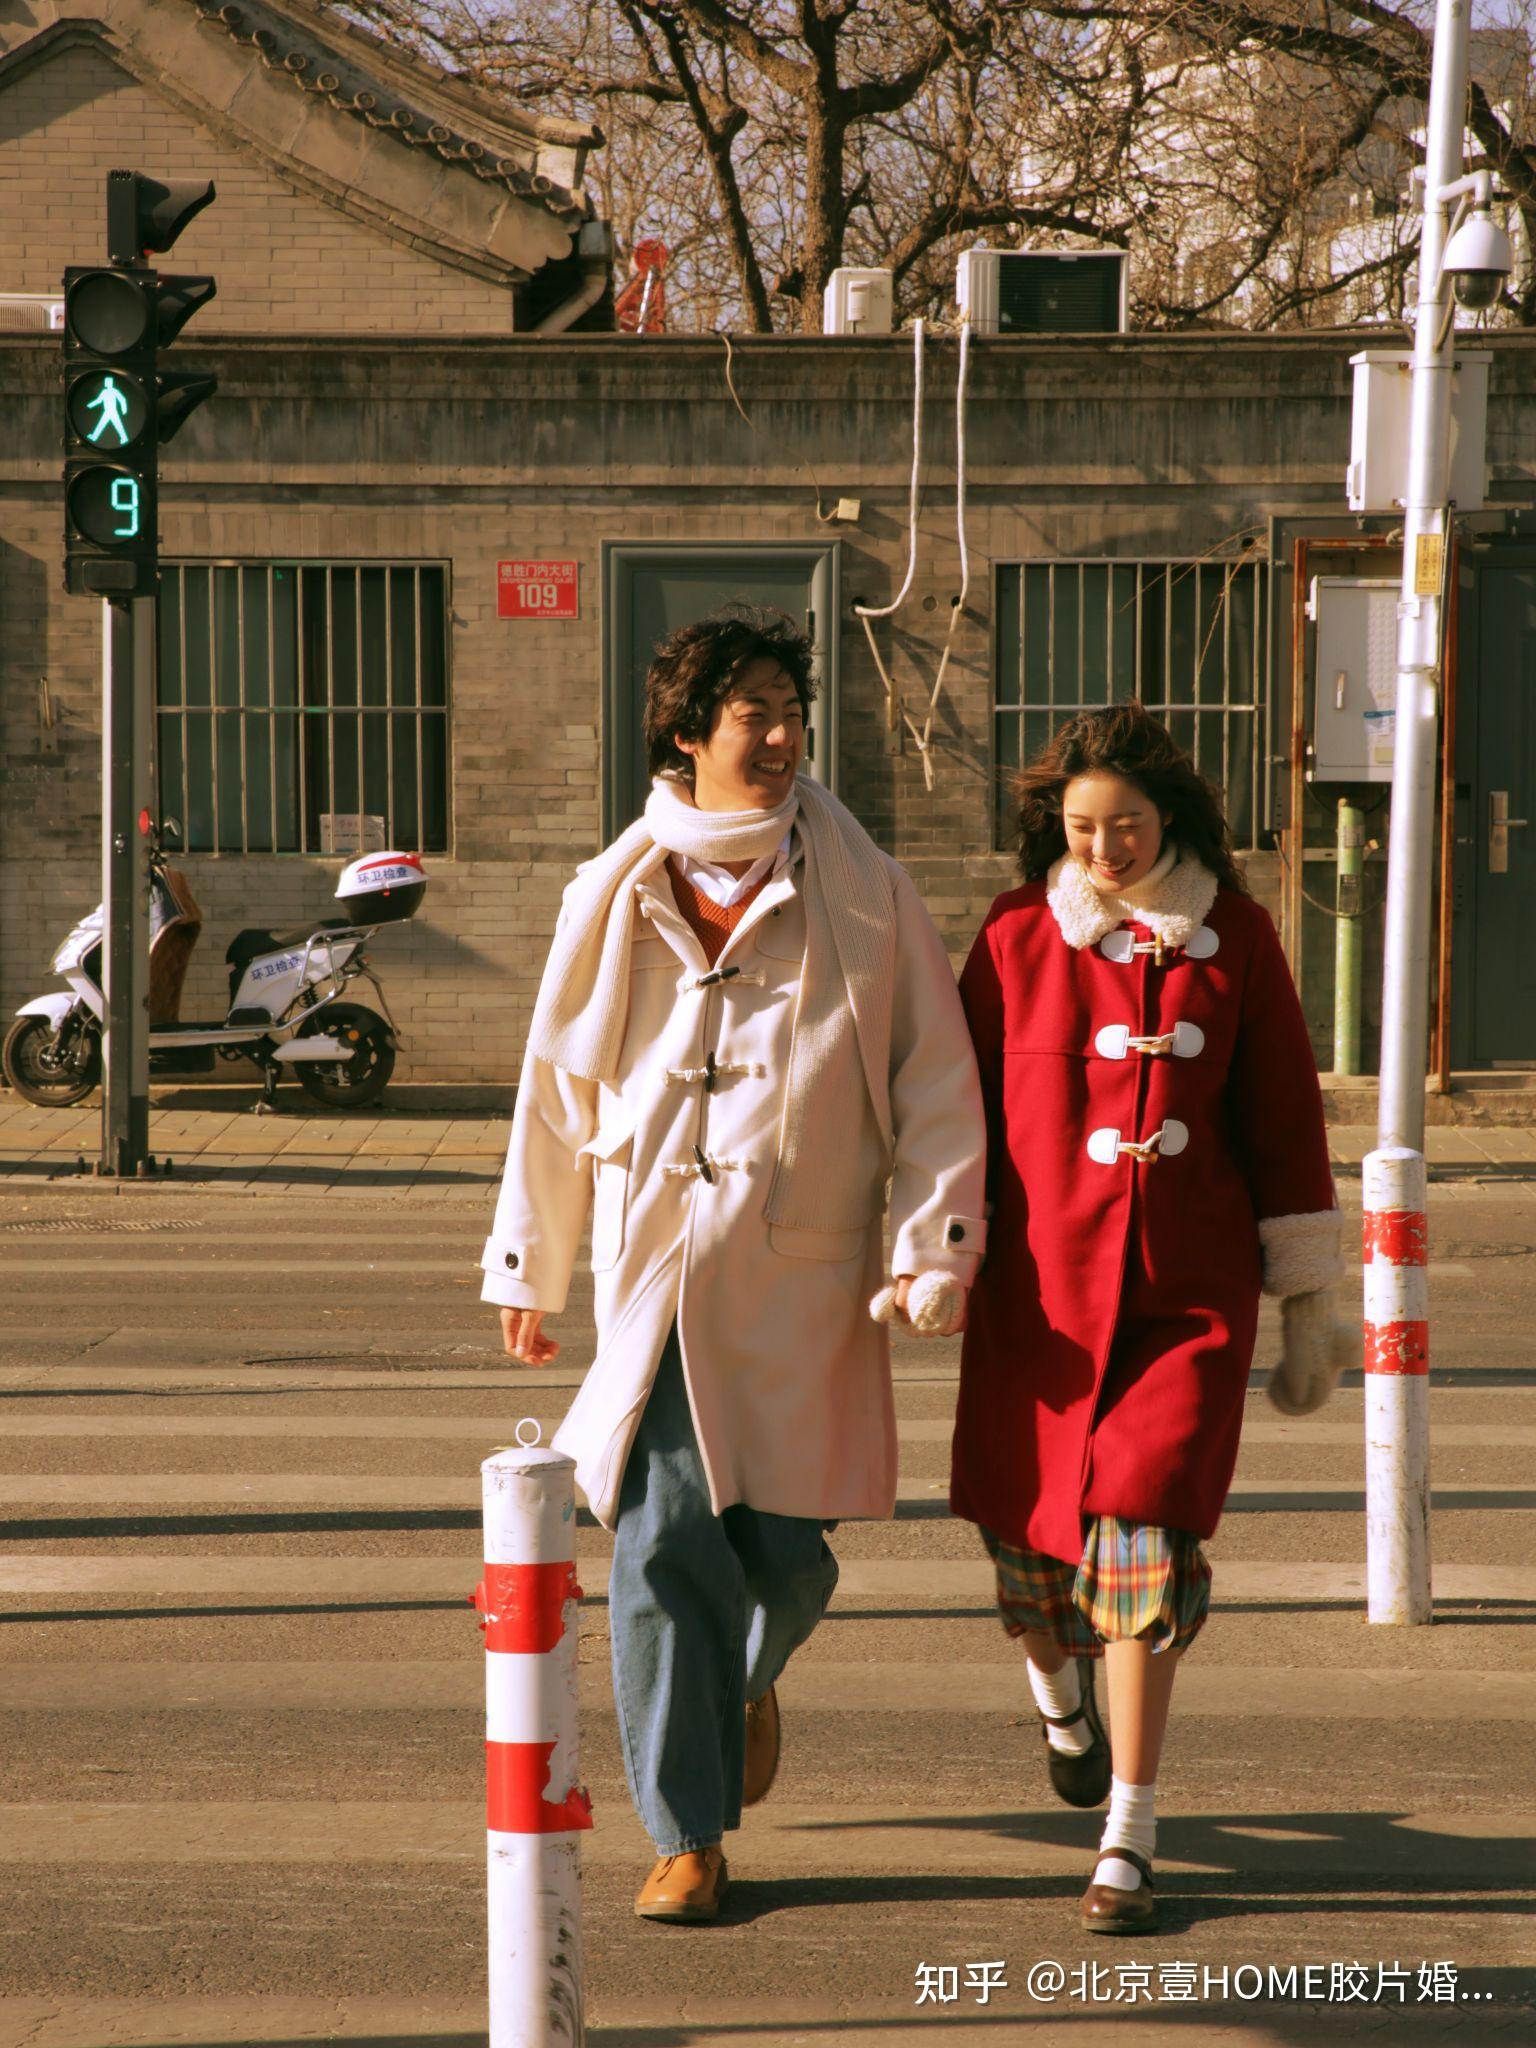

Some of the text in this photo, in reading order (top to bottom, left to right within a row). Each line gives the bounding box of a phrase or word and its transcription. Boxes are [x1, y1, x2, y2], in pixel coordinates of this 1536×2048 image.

[111, 478, 138, 536] 9
[517, 584, 558, 608] 109
[357, 867, 408, 884] 环卫检查
[251, 956, 300, 980] 环卫检查
